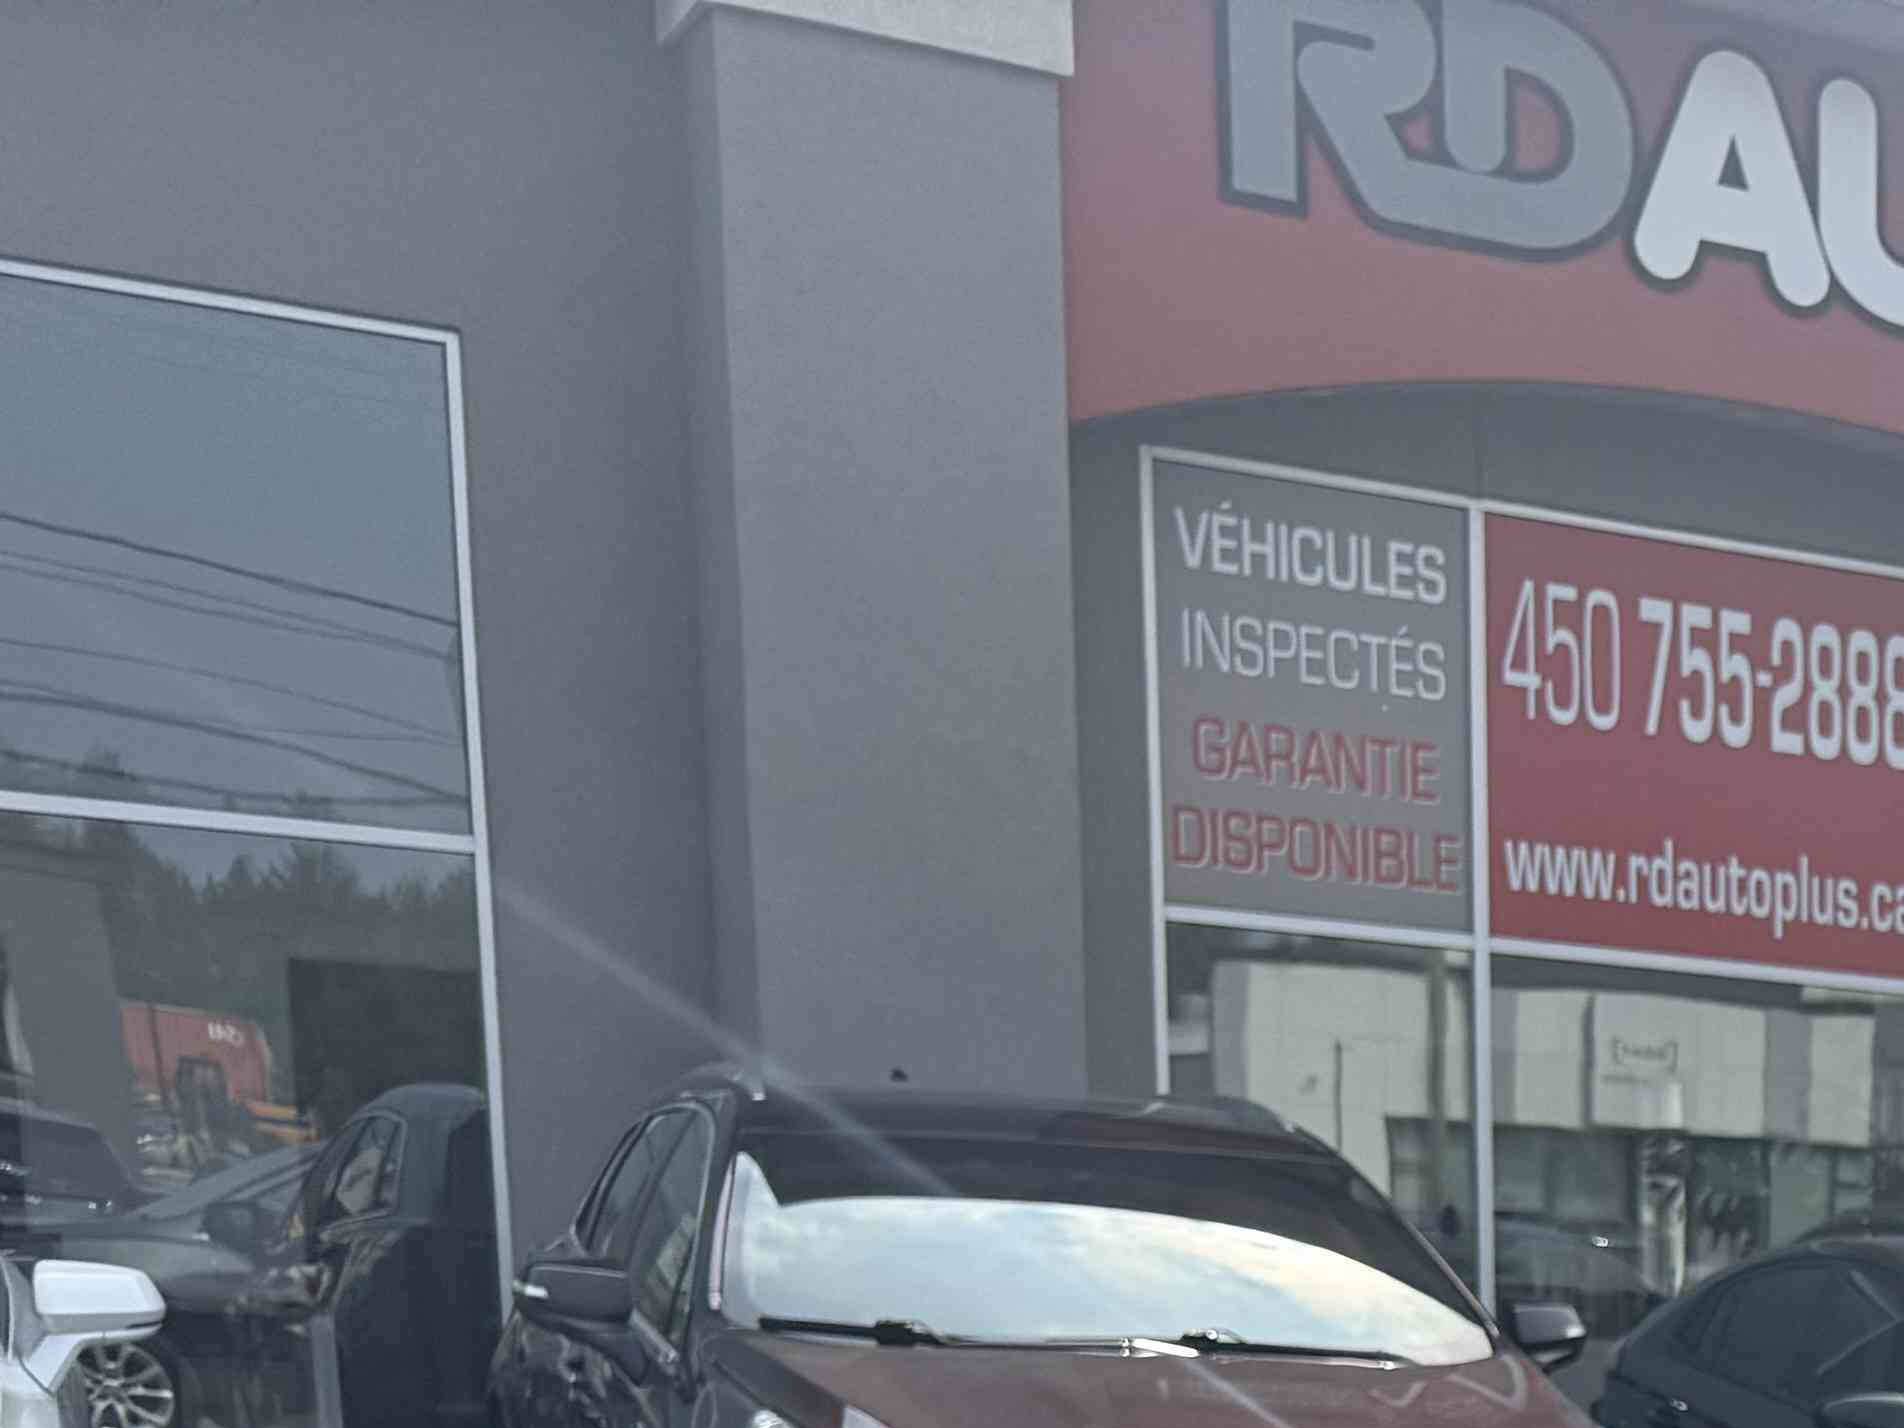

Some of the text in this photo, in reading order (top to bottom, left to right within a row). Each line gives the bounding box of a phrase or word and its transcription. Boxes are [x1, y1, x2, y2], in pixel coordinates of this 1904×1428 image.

[1174, 501, 1448, 604] VÉHICULES
[1180, 608, 1447, 701] INSPECTÉS
[1503, 578, 1621, 731] 450
[1193, 716, 1442, 805] GARANTIE
[1170, 804, 1464, 895] DISPONIBLE
